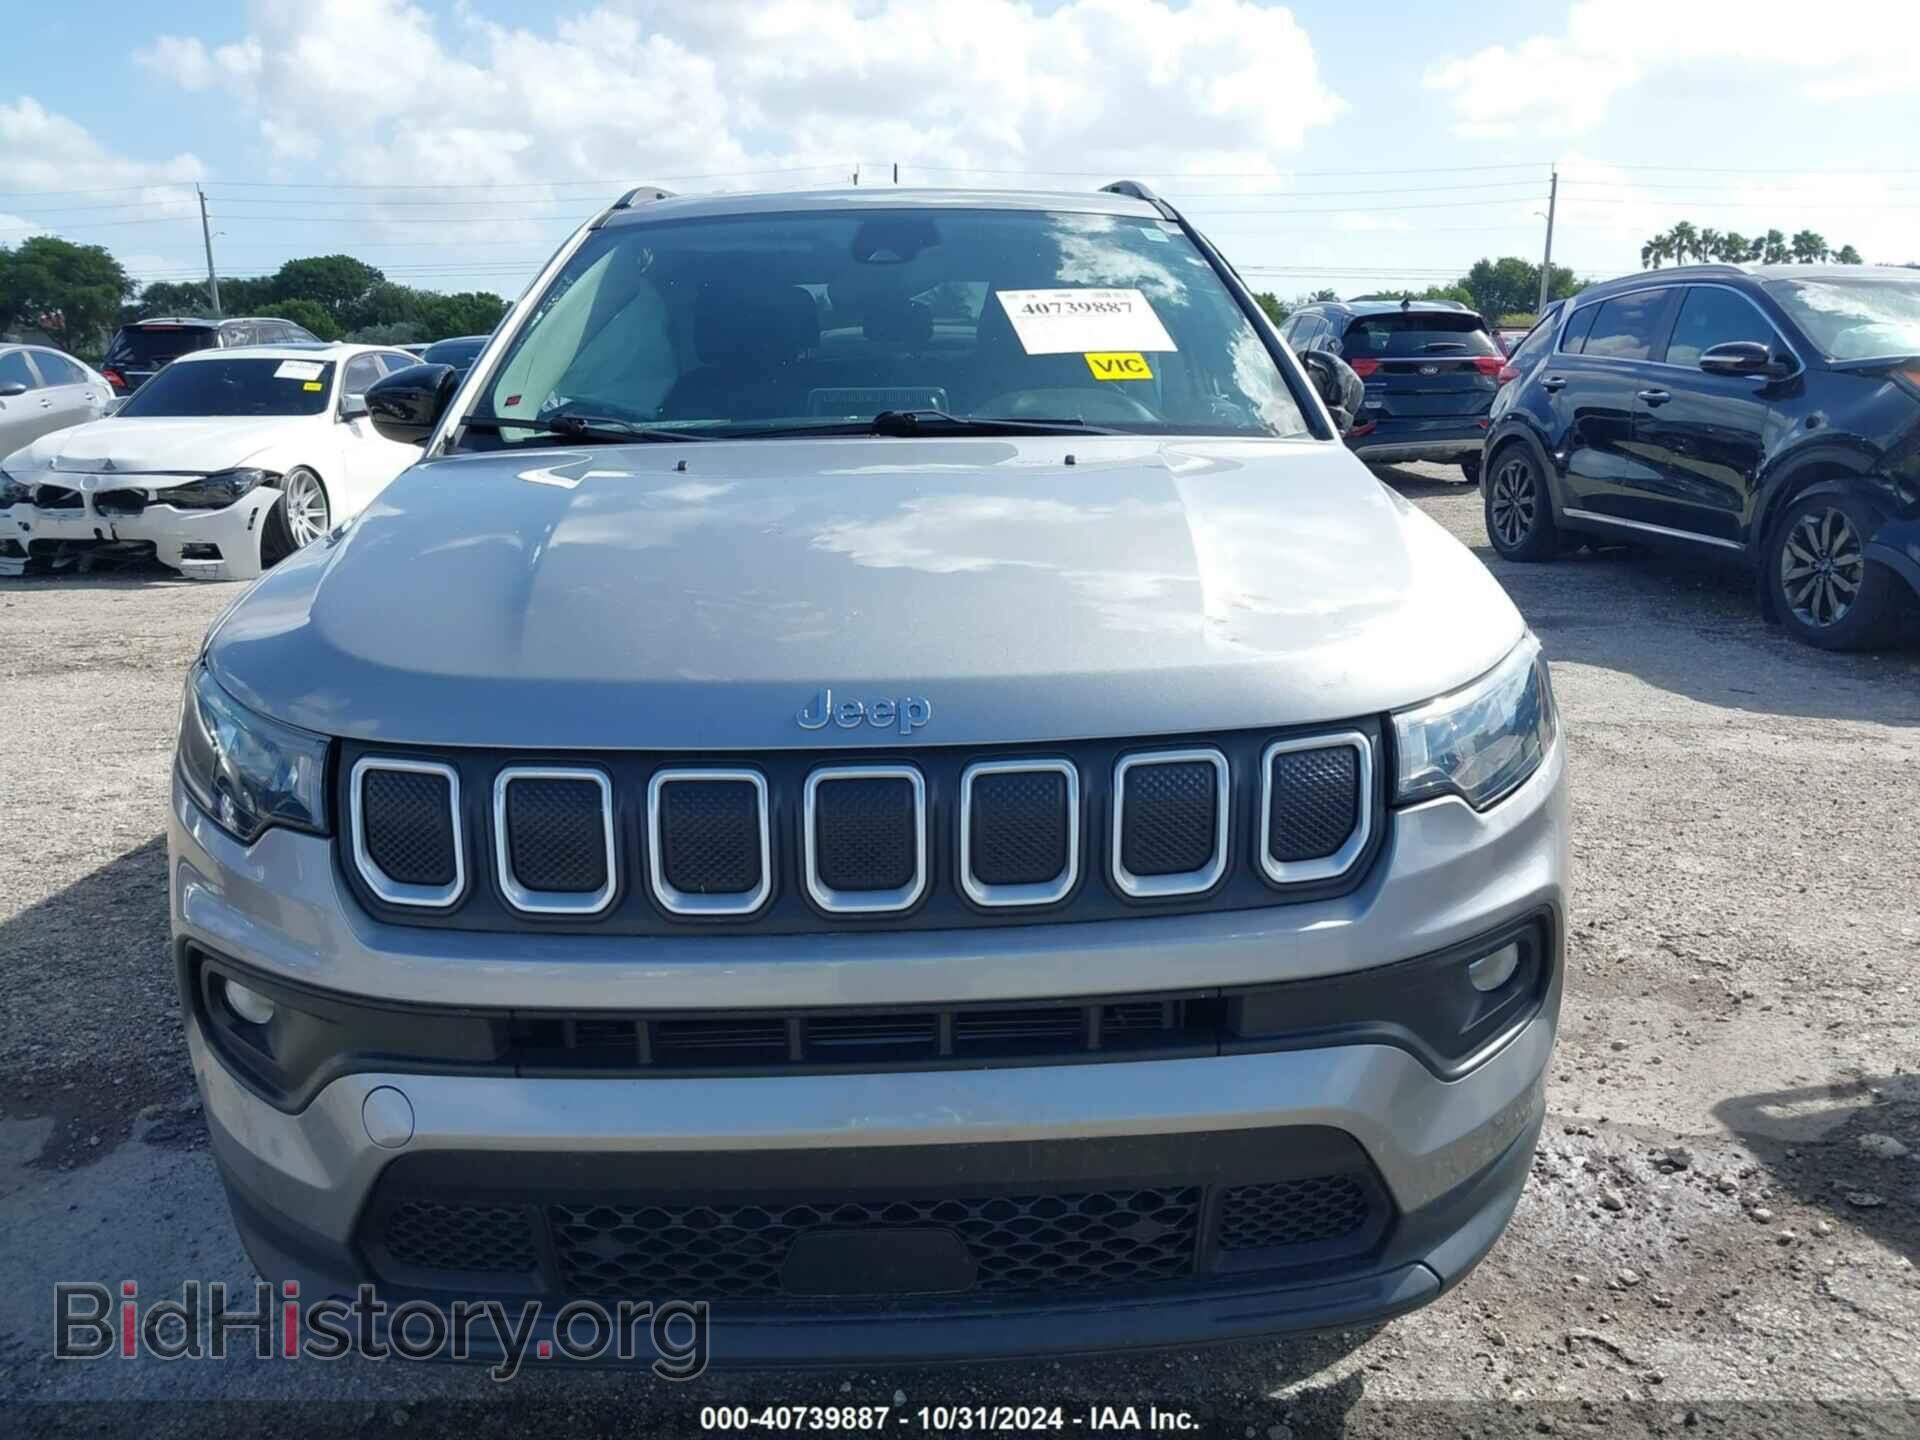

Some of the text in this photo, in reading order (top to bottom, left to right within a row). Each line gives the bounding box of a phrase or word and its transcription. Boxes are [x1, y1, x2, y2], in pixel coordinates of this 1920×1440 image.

[1021, 301, 1133, 315] 40739887
[1093, 359, 1144, 373] VIC
[796, 688, 933, 735] Jeep
